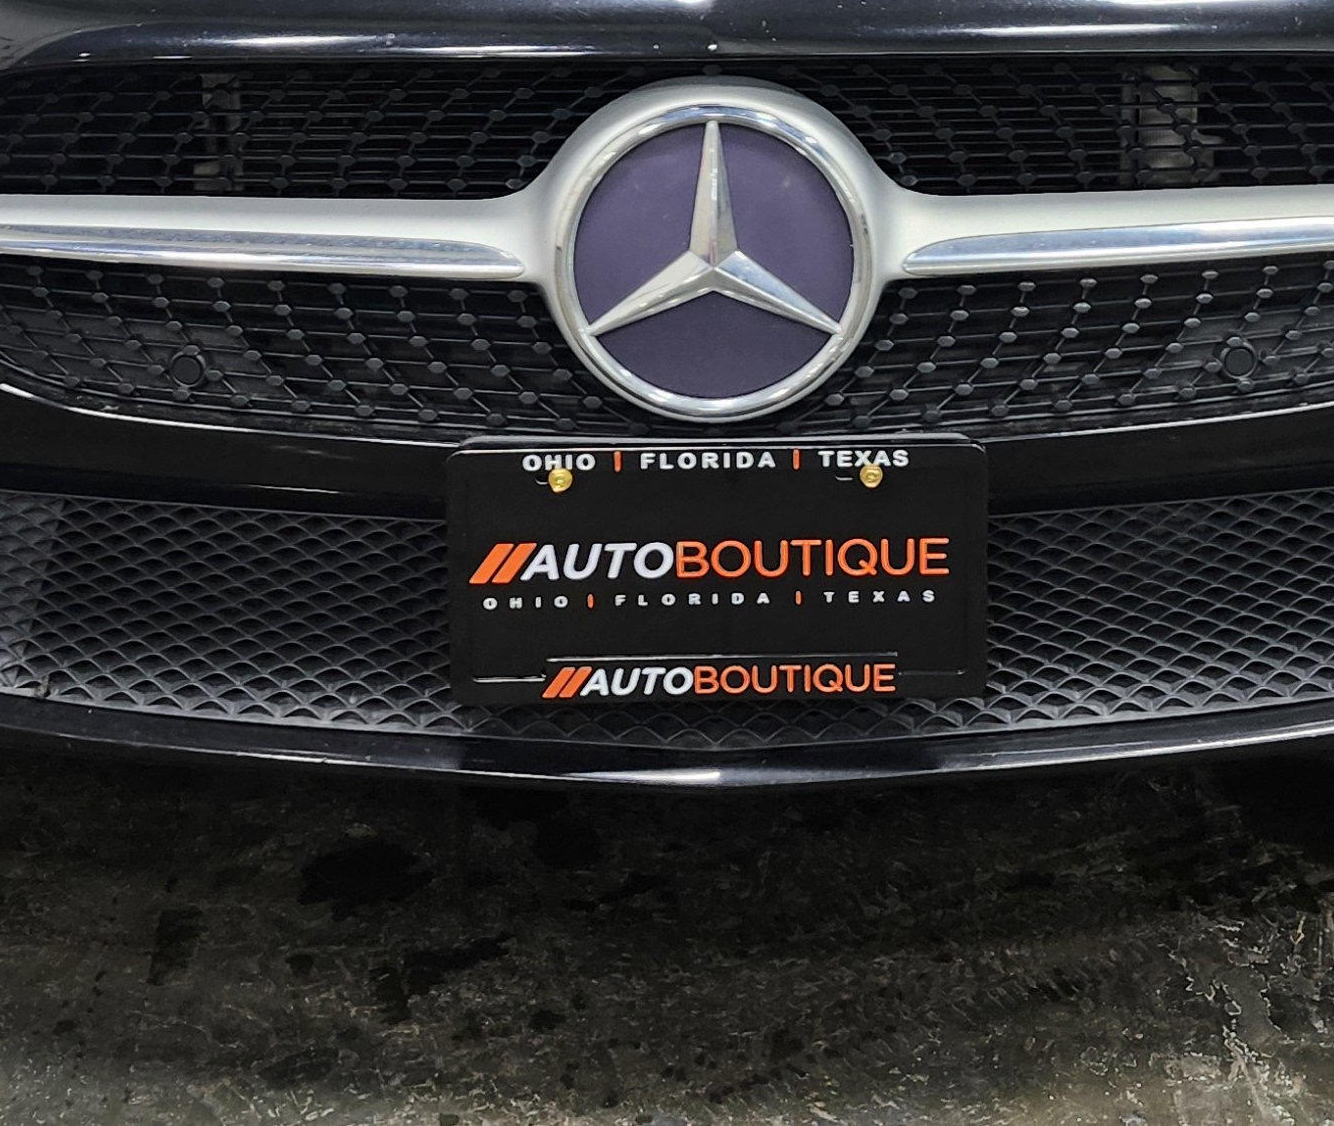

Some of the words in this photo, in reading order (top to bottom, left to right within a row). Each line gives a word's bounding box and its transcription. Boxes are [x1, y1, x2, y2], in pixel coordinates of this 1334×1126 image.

[522, 453, 596, 472] OHIO
[640, 451, 776, 470] FLORIDA
[819, 449, 909, 468] TEXAS
[520, 538, 950, 582] AUTOBOUTIQUE
[483, 595, 568, 610] OHIO
[614, 592, 770, 608] FLORIDA
[823, 589, 936, 604] TEXAS
[579, 663, 896, 697] AUTOBOUTIQUE
